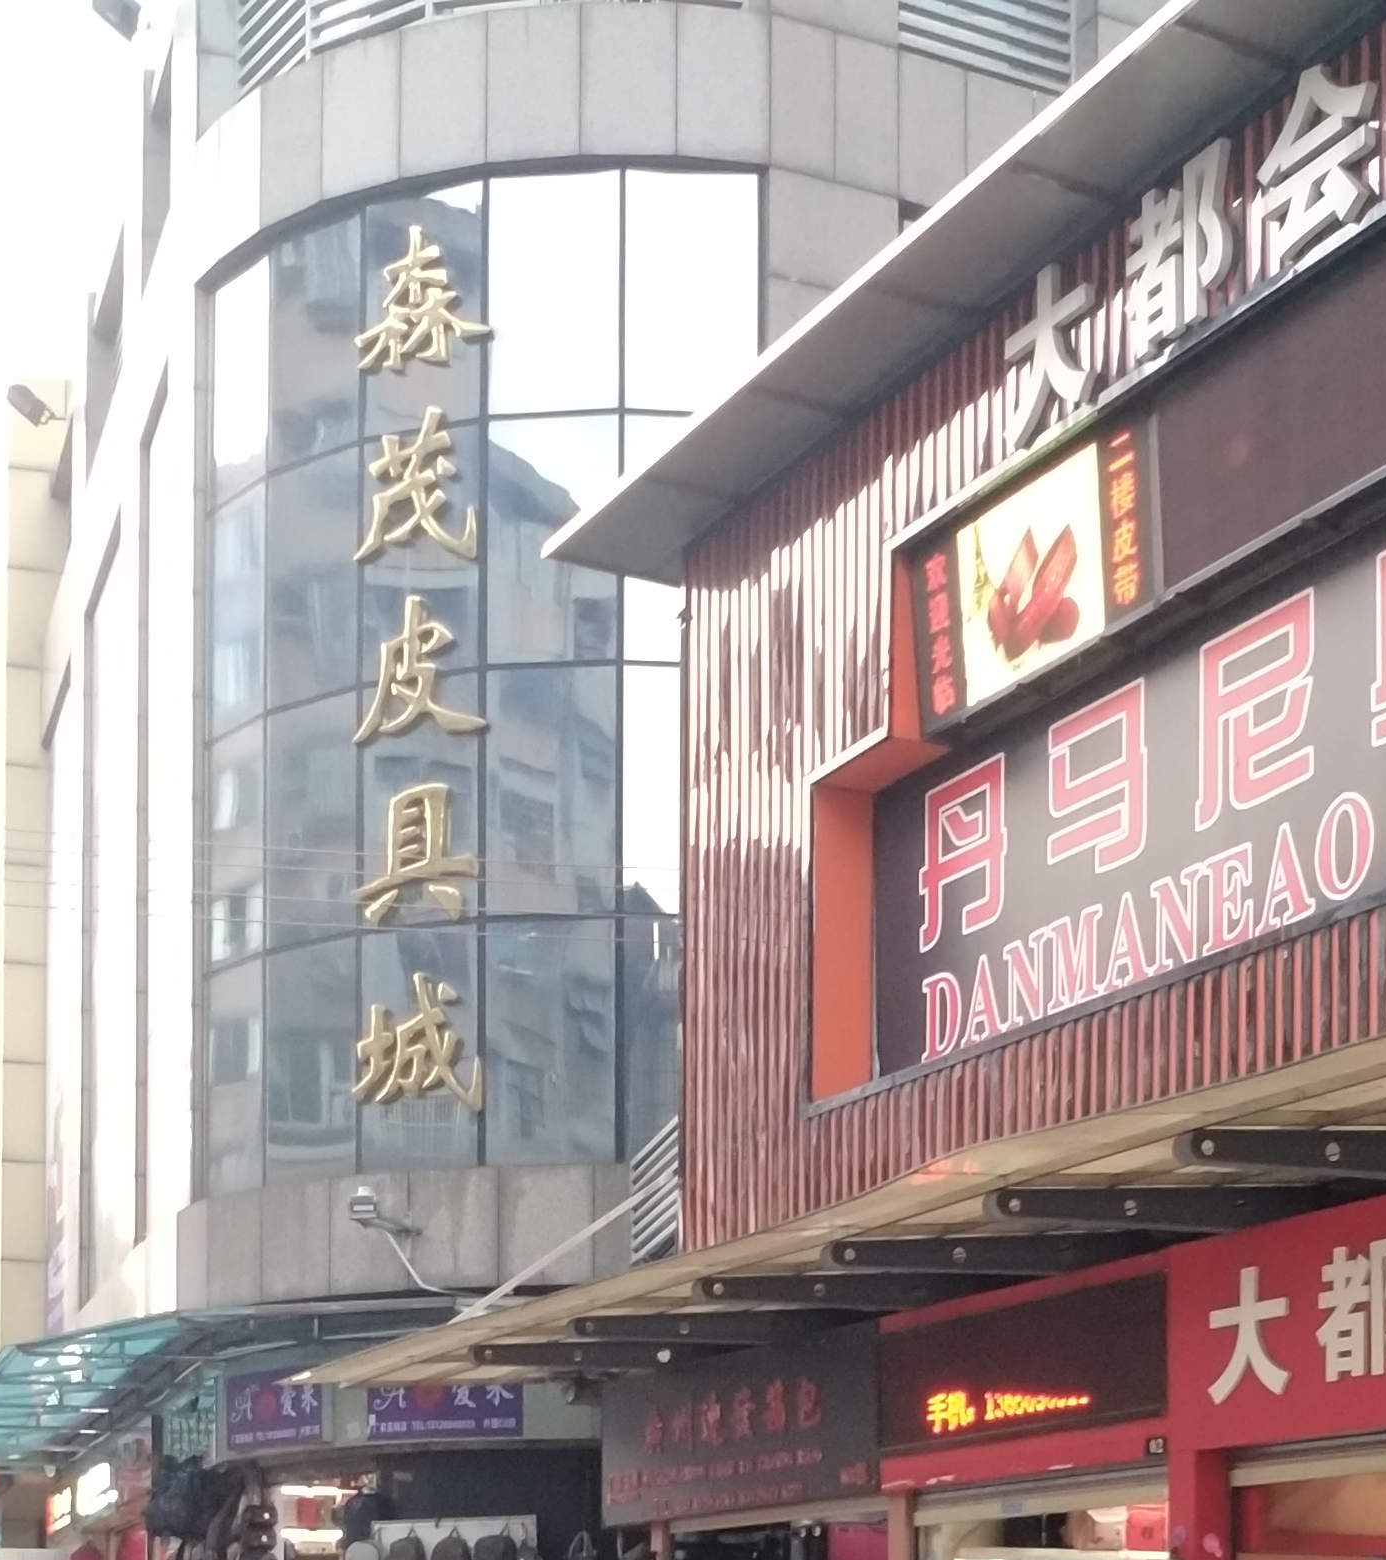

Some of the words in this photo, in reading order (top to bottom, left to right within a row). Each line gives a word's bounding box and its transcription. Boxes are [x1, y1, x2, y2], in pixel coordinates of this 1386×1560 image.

[352, 226, 491, 1112] 森茂皮具城
[922, 792, 1376, 1063] DANMANEAO
